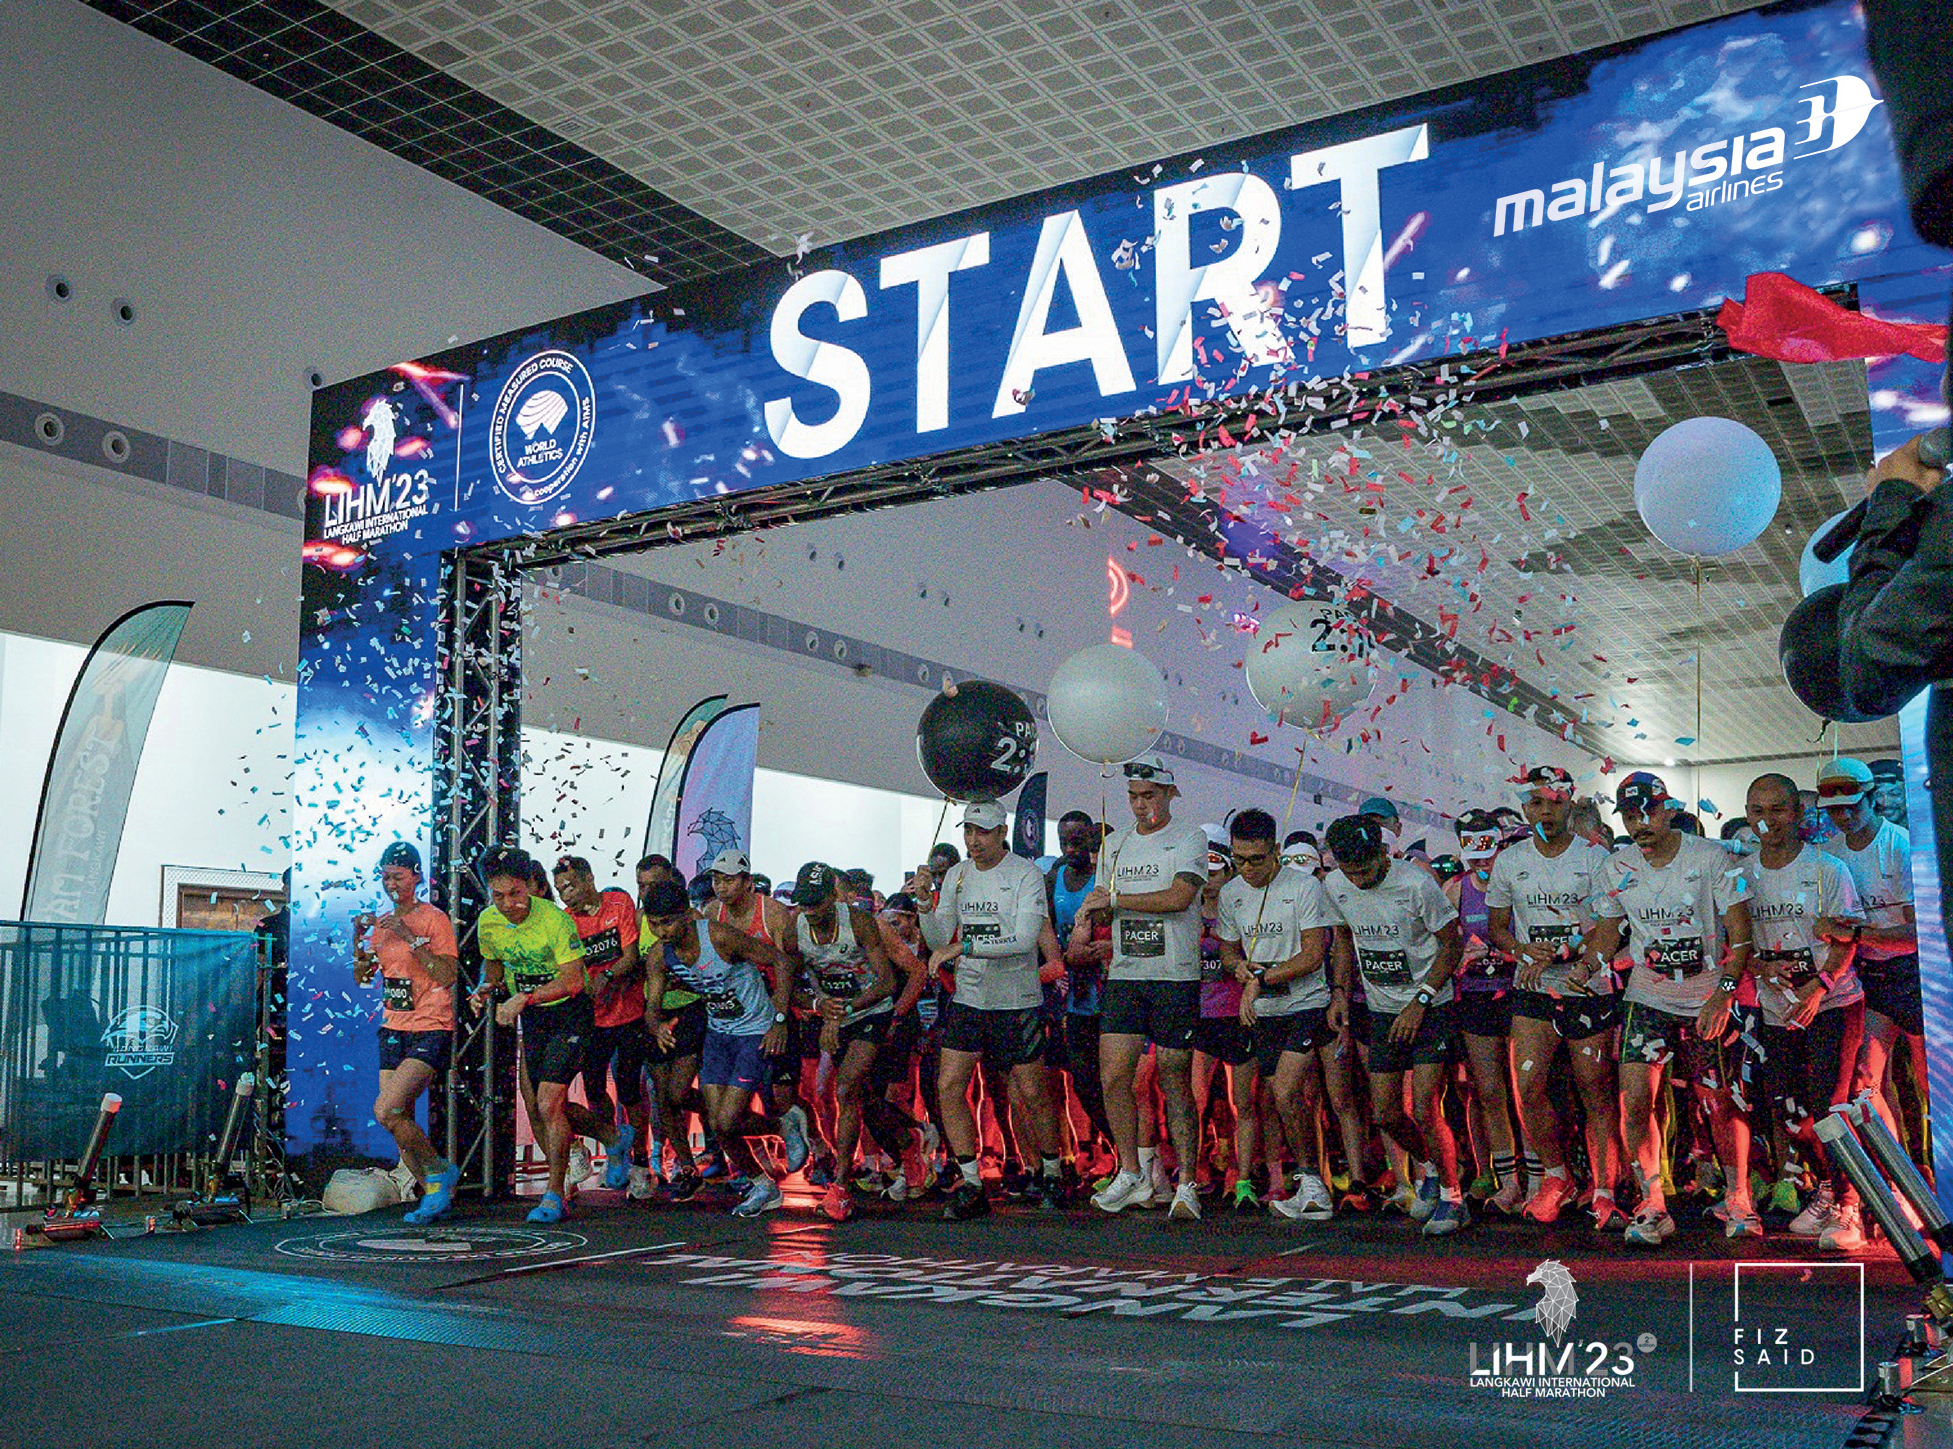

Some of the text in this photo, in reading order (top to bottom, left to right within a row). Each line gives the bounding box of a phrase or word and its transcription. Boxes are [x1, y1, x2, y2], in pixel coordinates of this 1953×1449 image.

[1493, 127, 1786, 238] malaysia
[1686, 170, 1784, 212] airlines
[764, 123, 1429, 459] START
[494, 357, 574, 473] CERTIFIED MEASURED COURSE
[517, 448, 564, 468] ATHLETICS
[525, 438, 557, 455] WORLD
[534, 396, 592, 497] cooperation with AIMS
[323, 504, 429, 539] LANGKAWI INTERNATIONAL
[342, 520, 409, 545] HALF MARATHON
[55, 729, 123, 863] FOREST
[87, 830, 107, 894] LANGKAWI
[1125, 930, 1159, 940] PACER
[1365, 960, 1403, 971] PACER
[107, 1054, 173, 1065] RUNNERS
[764, 1250, 1470, 1300] HALF MARATHON
[680, 1272, 1354, 1328] LANGKAWI
